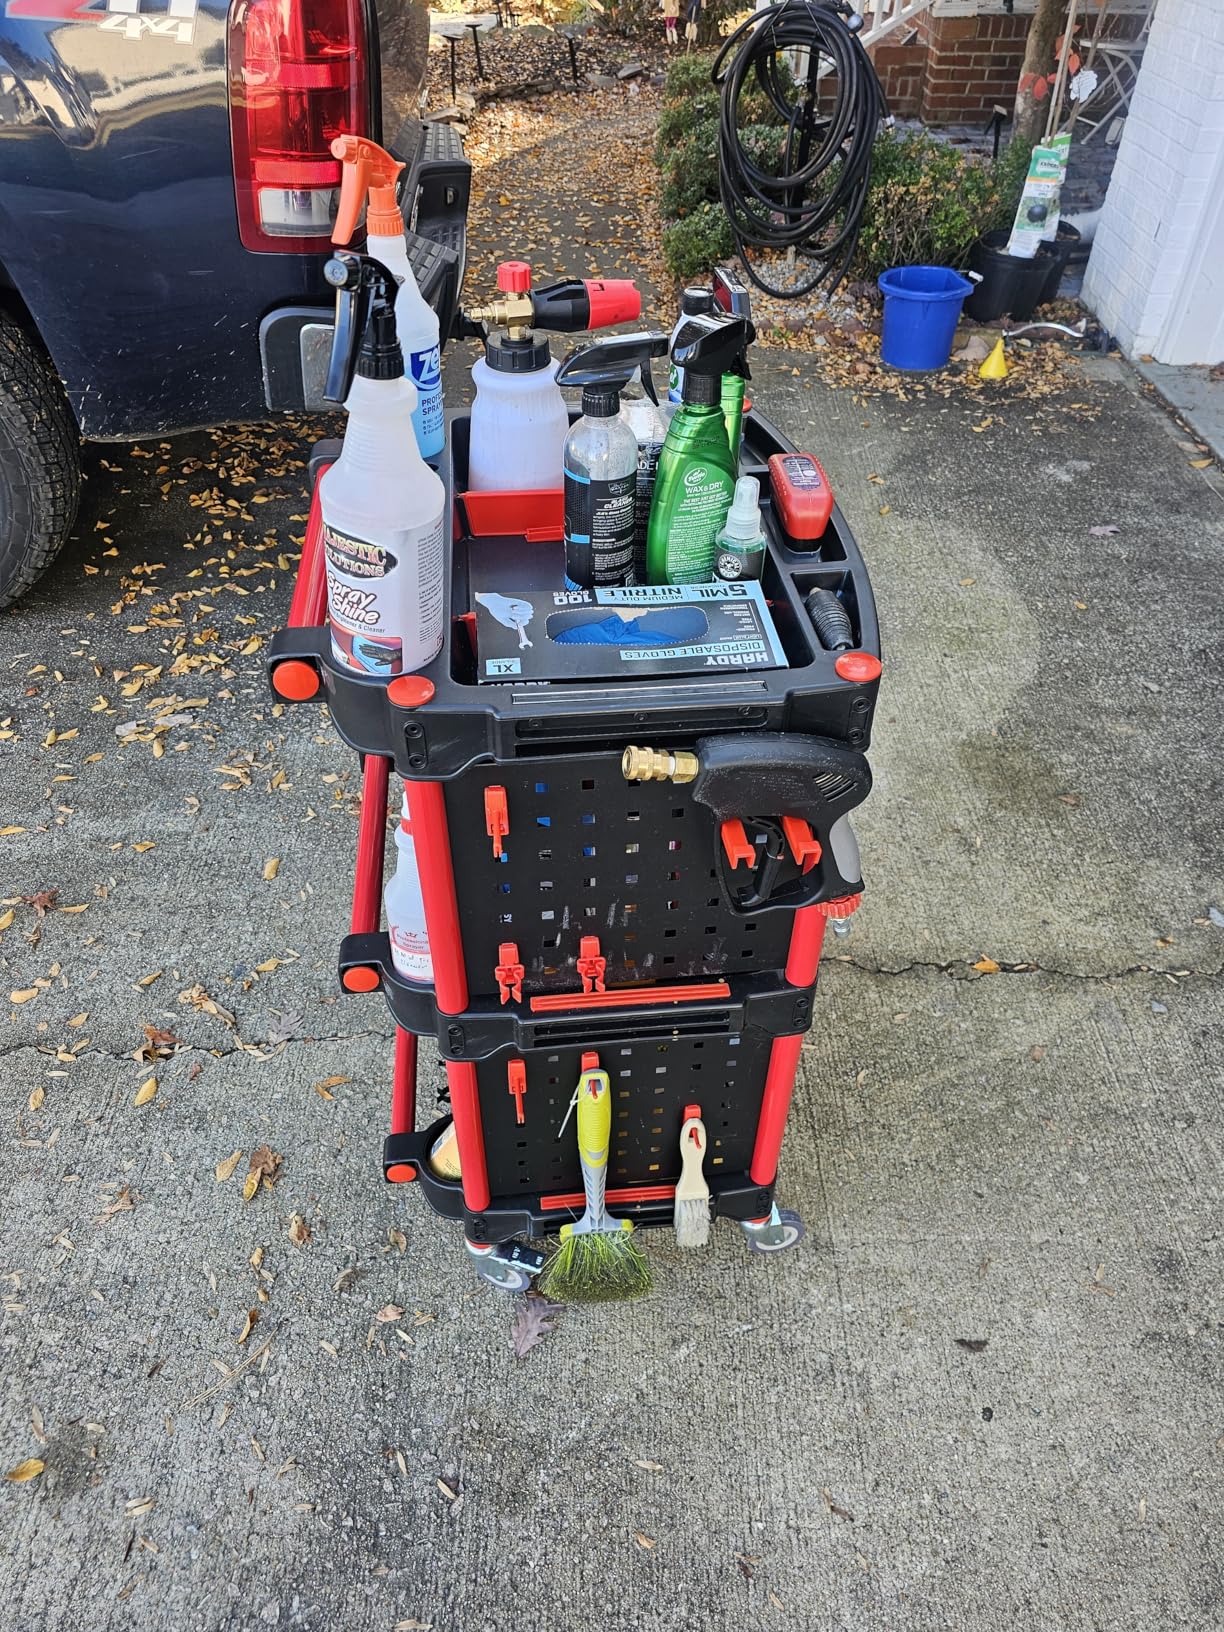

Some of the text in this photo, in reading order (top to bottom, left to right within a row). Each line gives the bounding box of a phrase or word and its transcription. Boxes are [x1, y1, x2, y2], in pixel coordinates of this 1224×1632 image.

[685, 486, 704, 494] WAX
[709, 480, 724, 490] DRY
[323, 525, 387, 567] AJESTIC
[328, 570, 377, 609] Spray
[603, 587, 682, 597] NITRILE
[692, 584, 748, 598] 5 MIL
[553, 595, 592, 605] 100
[332, 595, 380, 625] Shine
[363, 624, 386, 634] Cleaner
[624, 641, 761, 659] DISPOSABLE GLOVES
[706, 652, 769, 666] HARDY
[492, 664, 514, 673] XL
